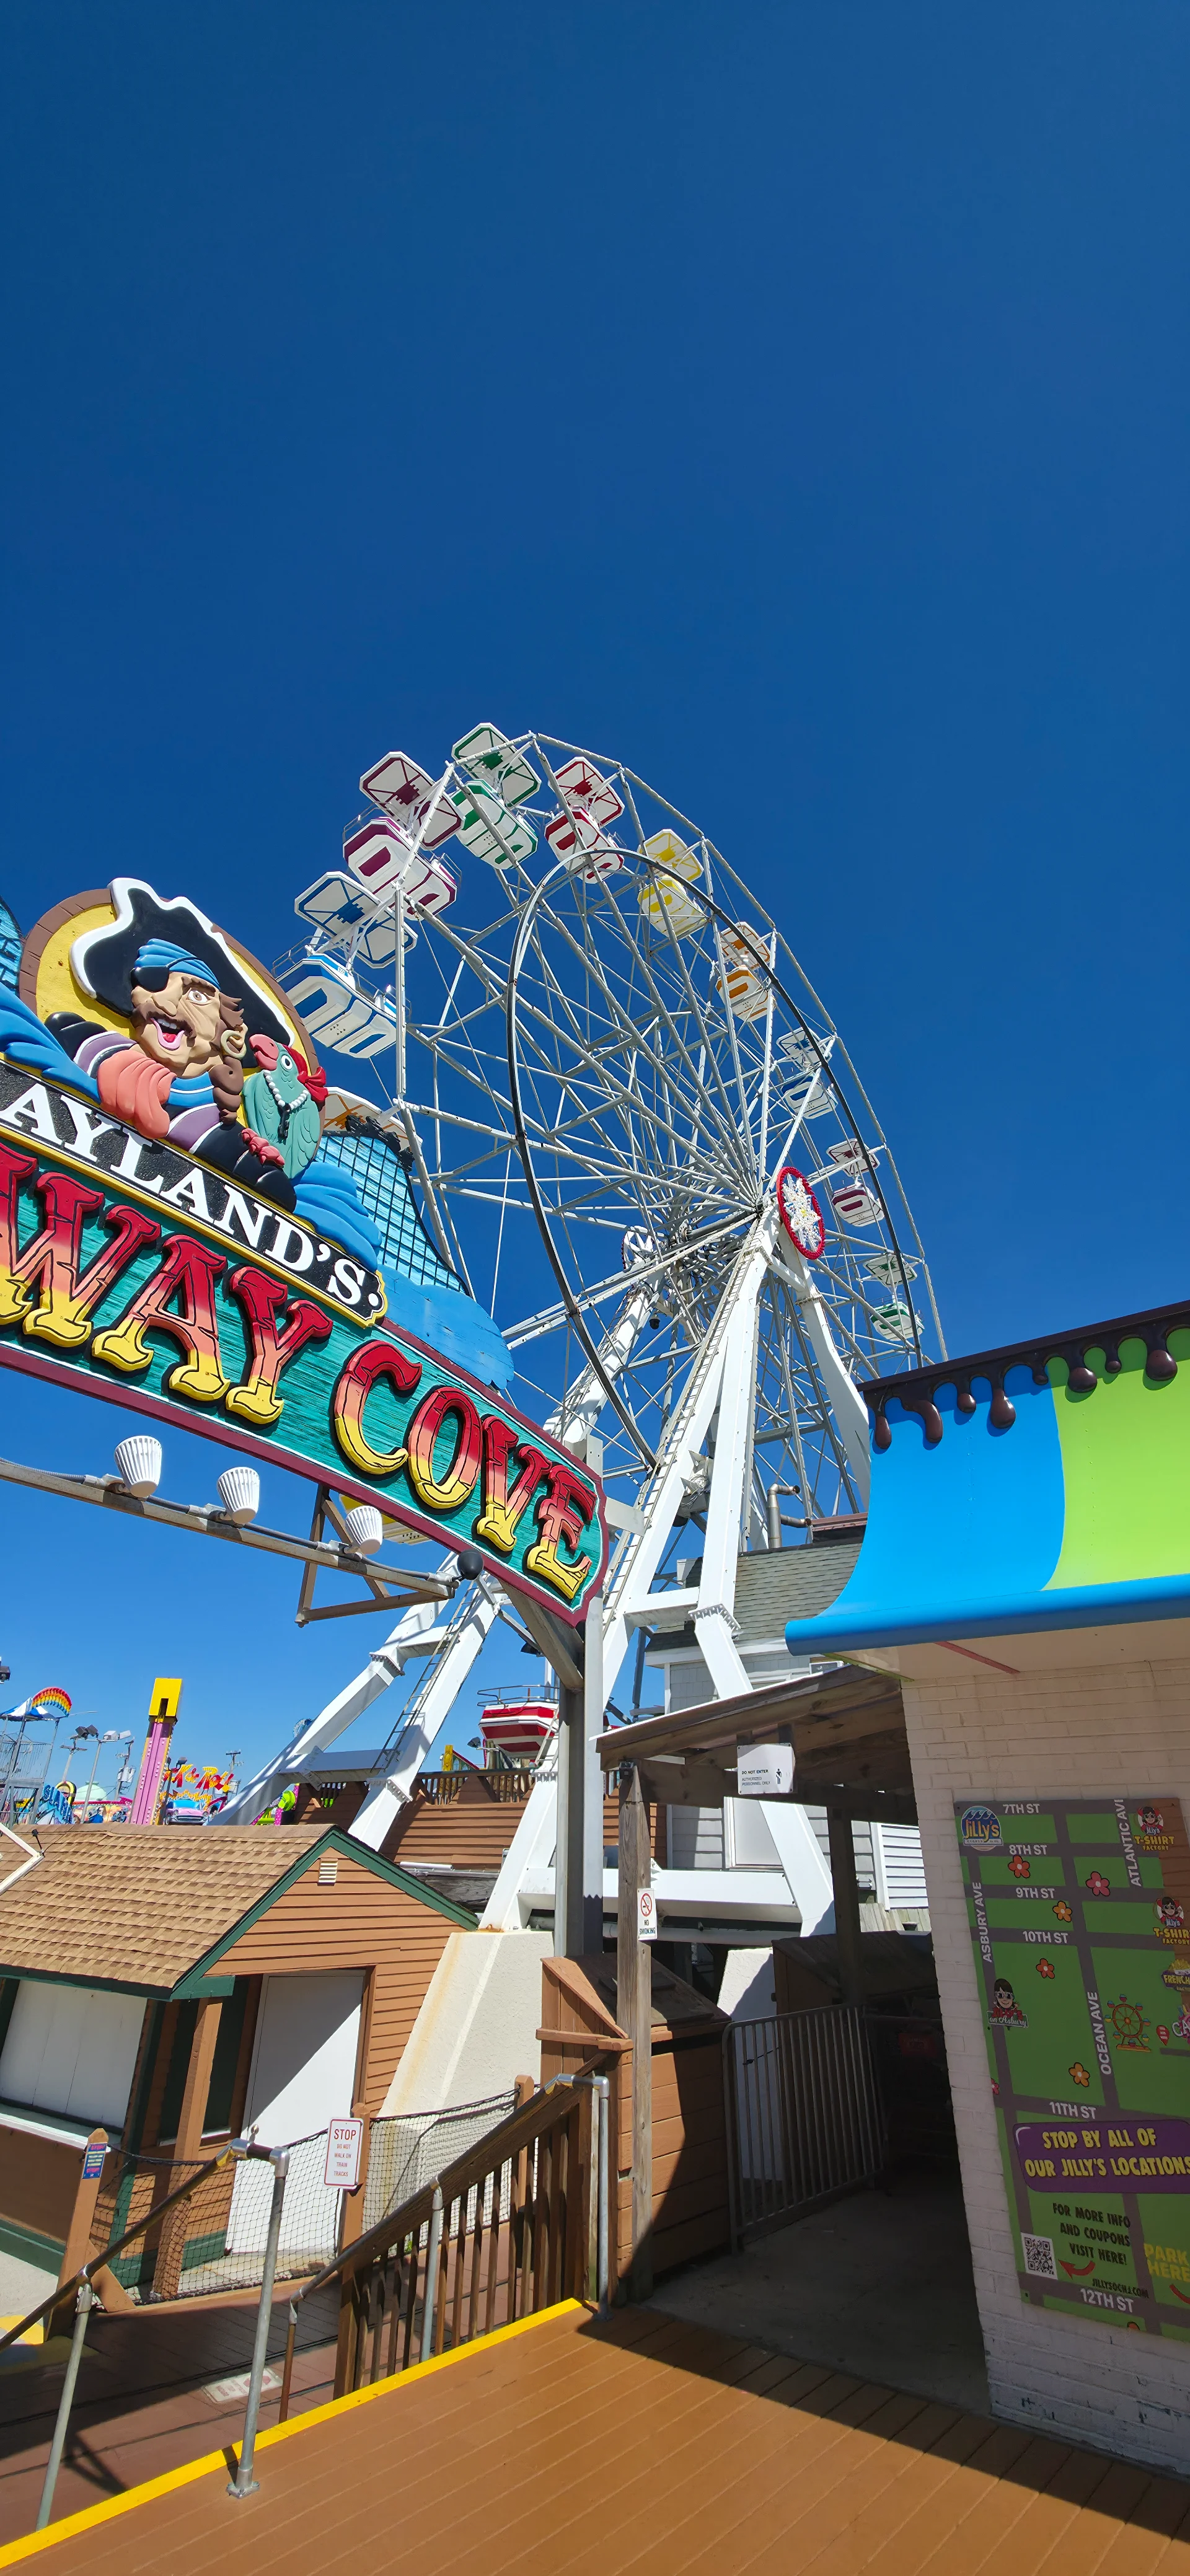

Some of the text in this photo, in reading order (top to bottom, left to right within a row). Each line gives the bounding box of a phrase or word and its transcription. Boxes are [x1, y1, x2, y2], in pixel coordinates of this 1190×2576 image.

[335, 1340, 597, 1599] COVE
[1003, 1803, 1040, 1814] 7TH ST
[1009, 1845, 1047, 1855] 8TH ST
[1134, 1835, 1175, 1845] T-SHIRT
[1119, 1822, 1143, 1887] ATLANTIC
[1016, 1888, 1055, 1899] 9TH ST
[972, 1882, 992, 1963] ASBURY AVE
[1023, 1931, 1069, 1944] 10TH ST
[1153, 1928, 1190, 1938] T-SHIR
[998, 2015, 1026, 2029] Asbury
[1088, 1992, 1112, 2075] OCEAN AVE
[1049, 2101, 1096, 2119] 11TH ST
[333, 2129, 356, 2140] STOP
[1042, 2127, 1157, 2149] STOP BY ALL OF
[1025, 2159, 1056, 2177] OUR
[1061, 2158, 1107, 2177] JILLY'S
[1053, 2203, 1131, 2228] FOR MORE INFO
[1060, 2222, 1130, 2247] AND COUPONS
[1069, 2243, 1127, 2266] VISIT HERE!
[1144, 2243, 1189, 2266] PARK
[1080, 2288, 1134, 2313] 12TH ST
